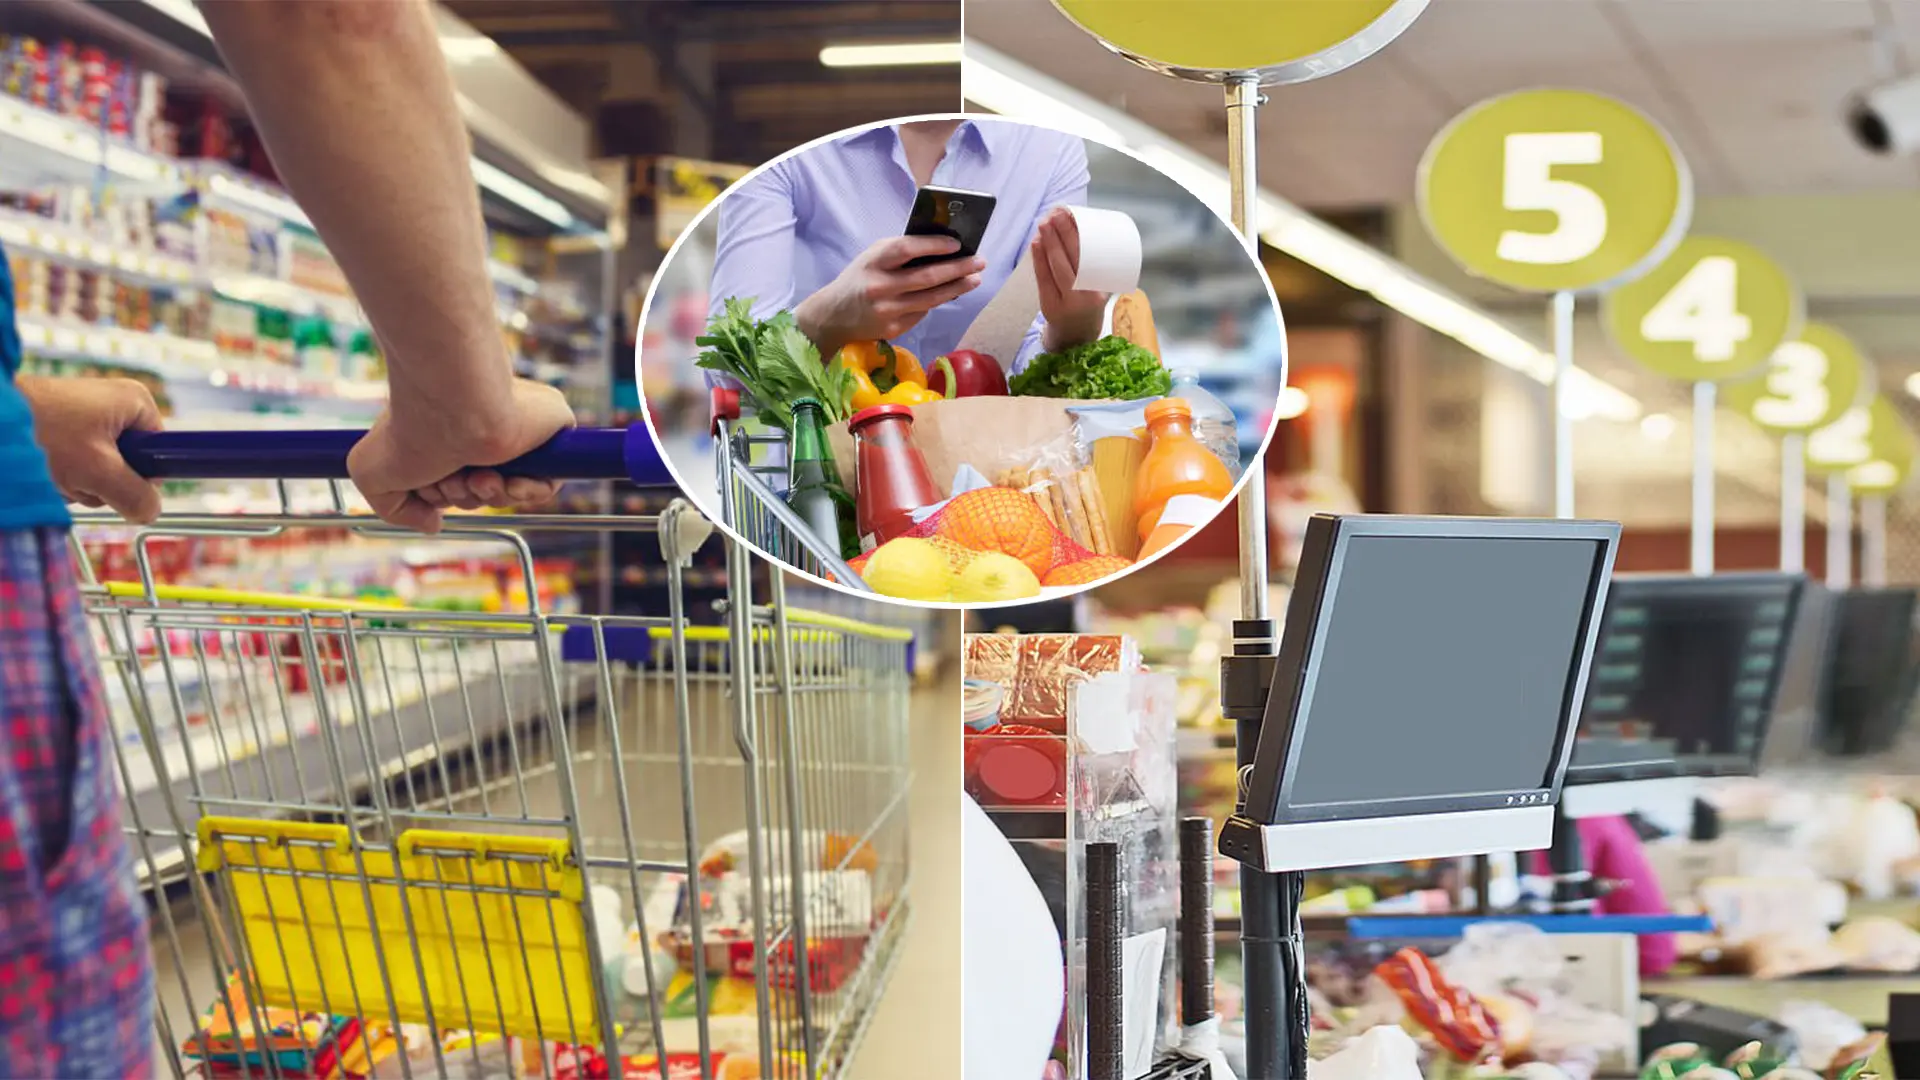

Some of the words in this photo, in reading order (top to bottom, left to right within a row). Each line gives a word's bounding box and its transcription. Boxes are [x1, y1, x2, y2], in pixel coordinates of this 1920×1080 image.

[1496, 131, 1608, 264] 5
[1640, 256, 1752, 362] 4
[1752, 341, 1829, 427] 3
